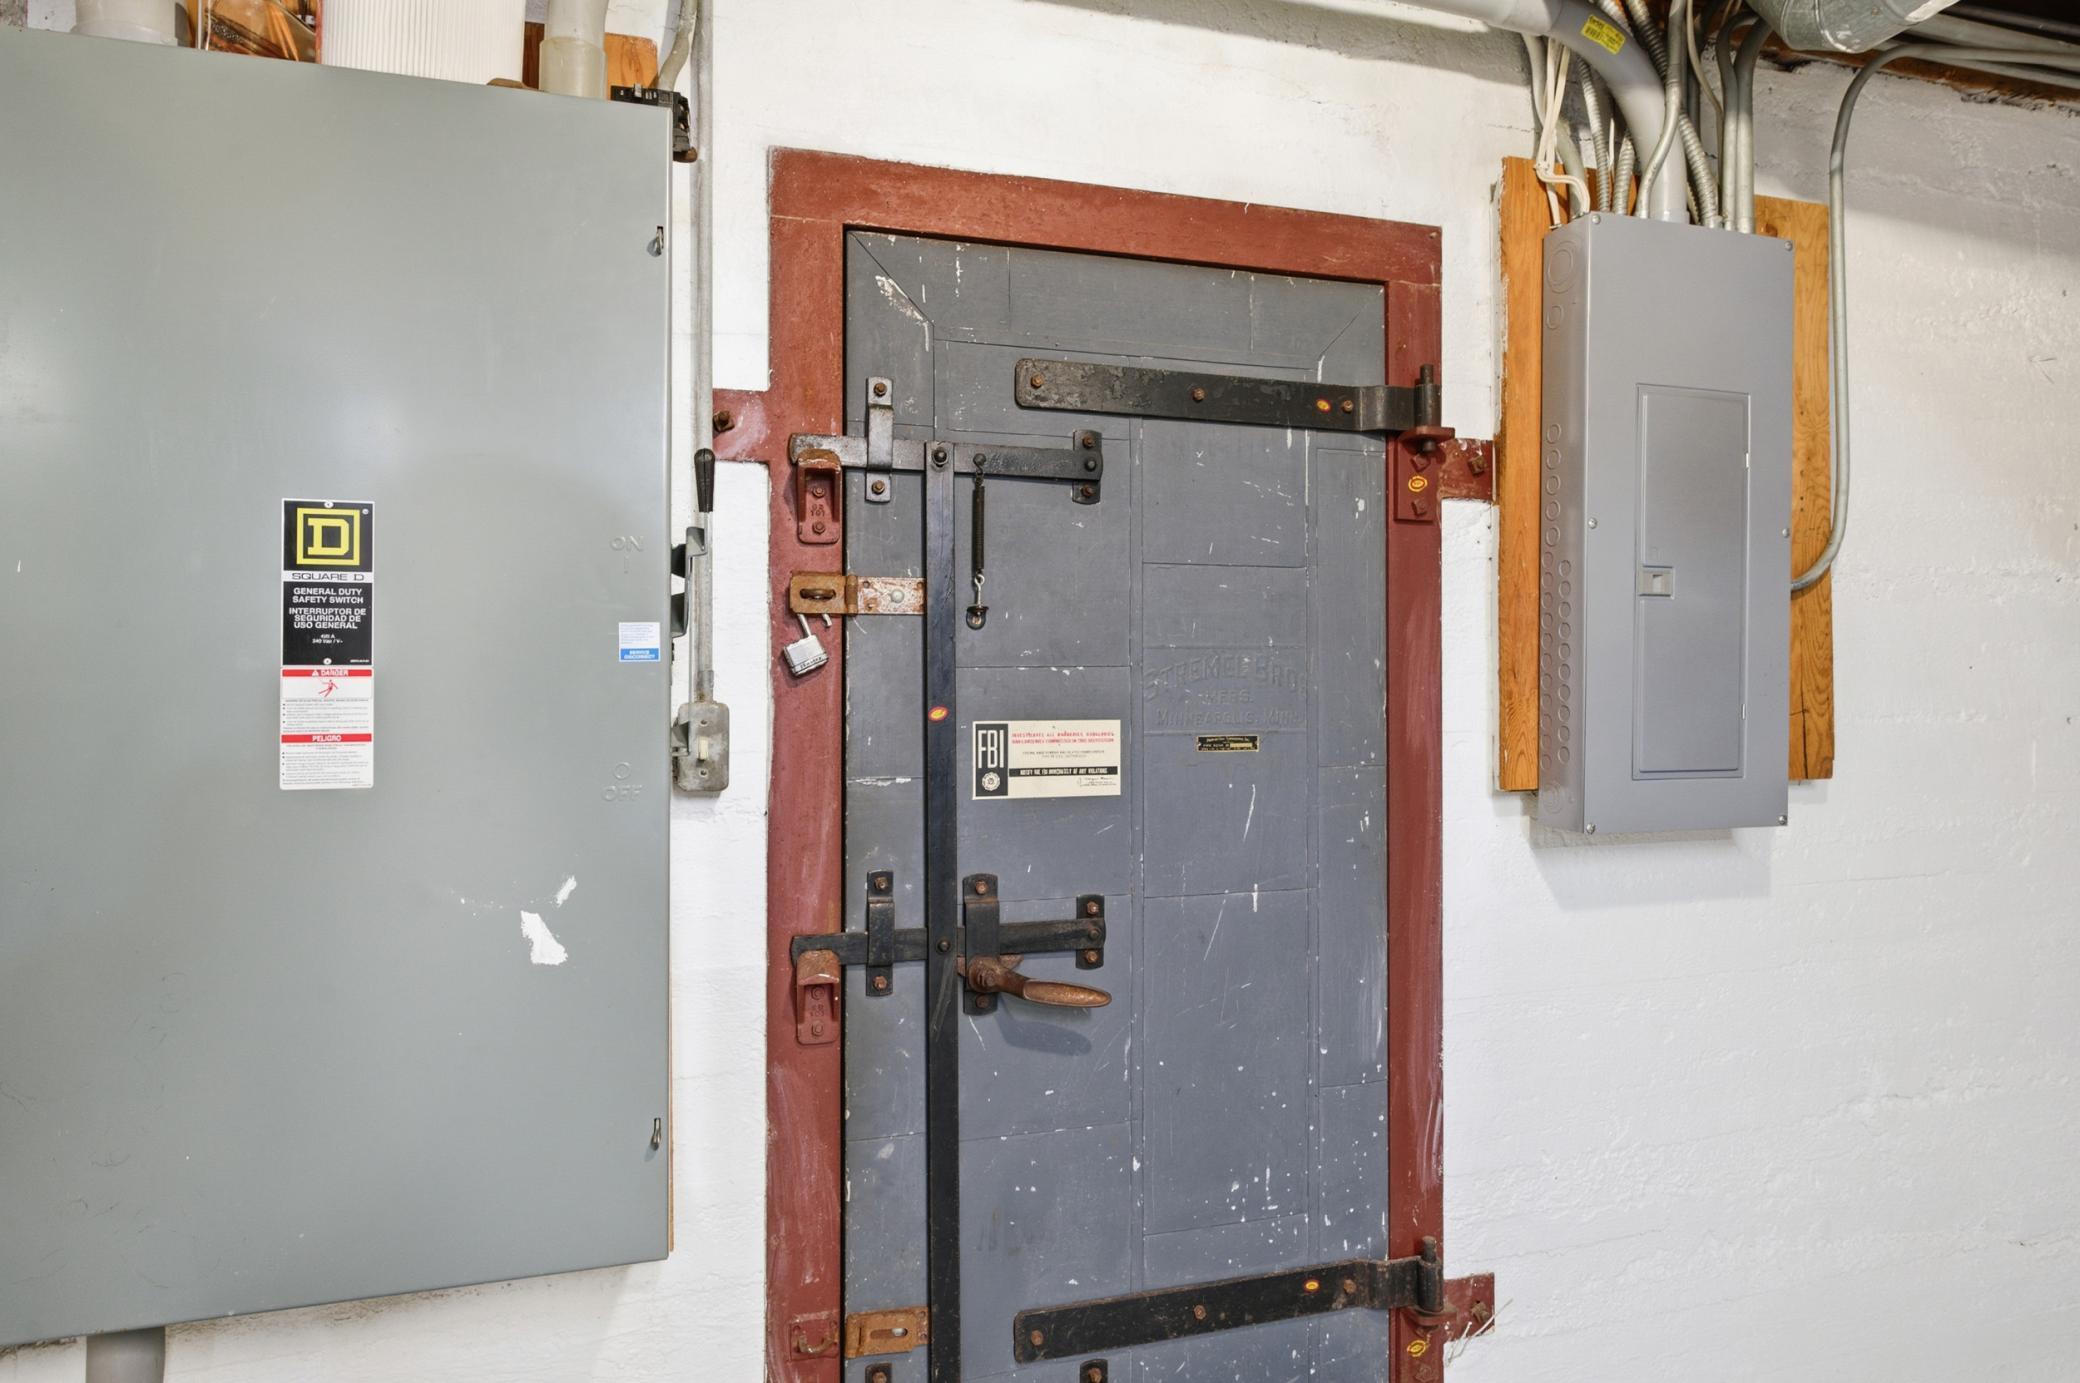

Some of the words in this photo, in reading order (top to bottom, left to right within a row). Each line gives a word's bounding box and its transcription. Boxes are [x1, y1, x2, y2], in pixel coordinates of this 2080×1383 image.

[610, 535, 644, 553] ON
[292, 572, 348, 581] SQUARE
[353, 573, 365, 581] D
[293, 587, 337, 596] GENERAL
[338, 588, 362, 596] DUTY
[292, 596, 328, 604] SAFETY
[329, 596, 364, 604] SWITCH
[288, 607, 352, 615] INTERRUPTOR
[354, 608, 367, 616] DE
[293, 621, 313, 629] USO
[320, 669, 349, 677] DANGER
[977, 729, 1005, 769] FBI
[602, 784, 643, 802] OFF
